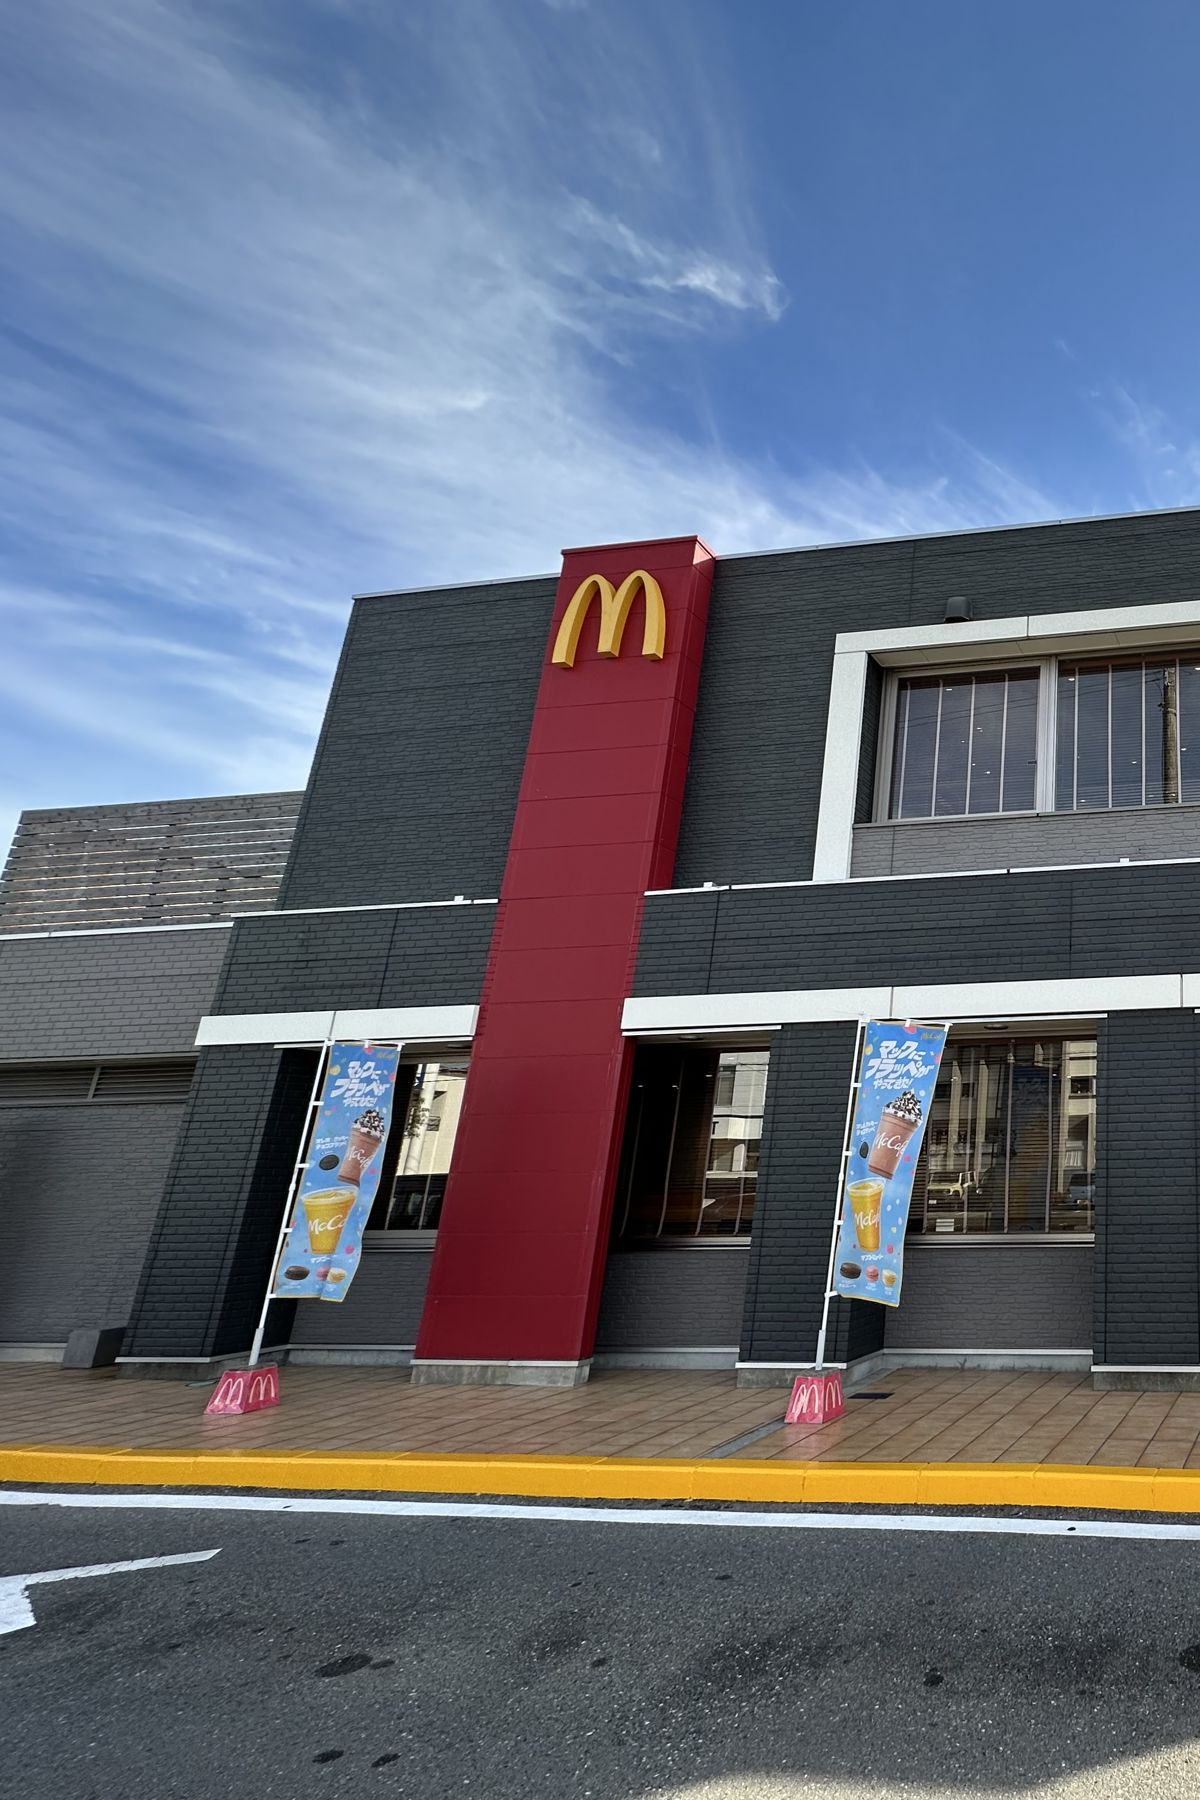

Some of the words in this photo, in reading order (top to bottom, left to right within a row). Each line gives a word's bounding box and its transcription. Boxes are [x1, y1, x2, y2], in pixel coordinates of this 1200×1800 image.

[879, 1040, 927, 1061] マックに
[864, 1058, 935, 1080] フラッペが
